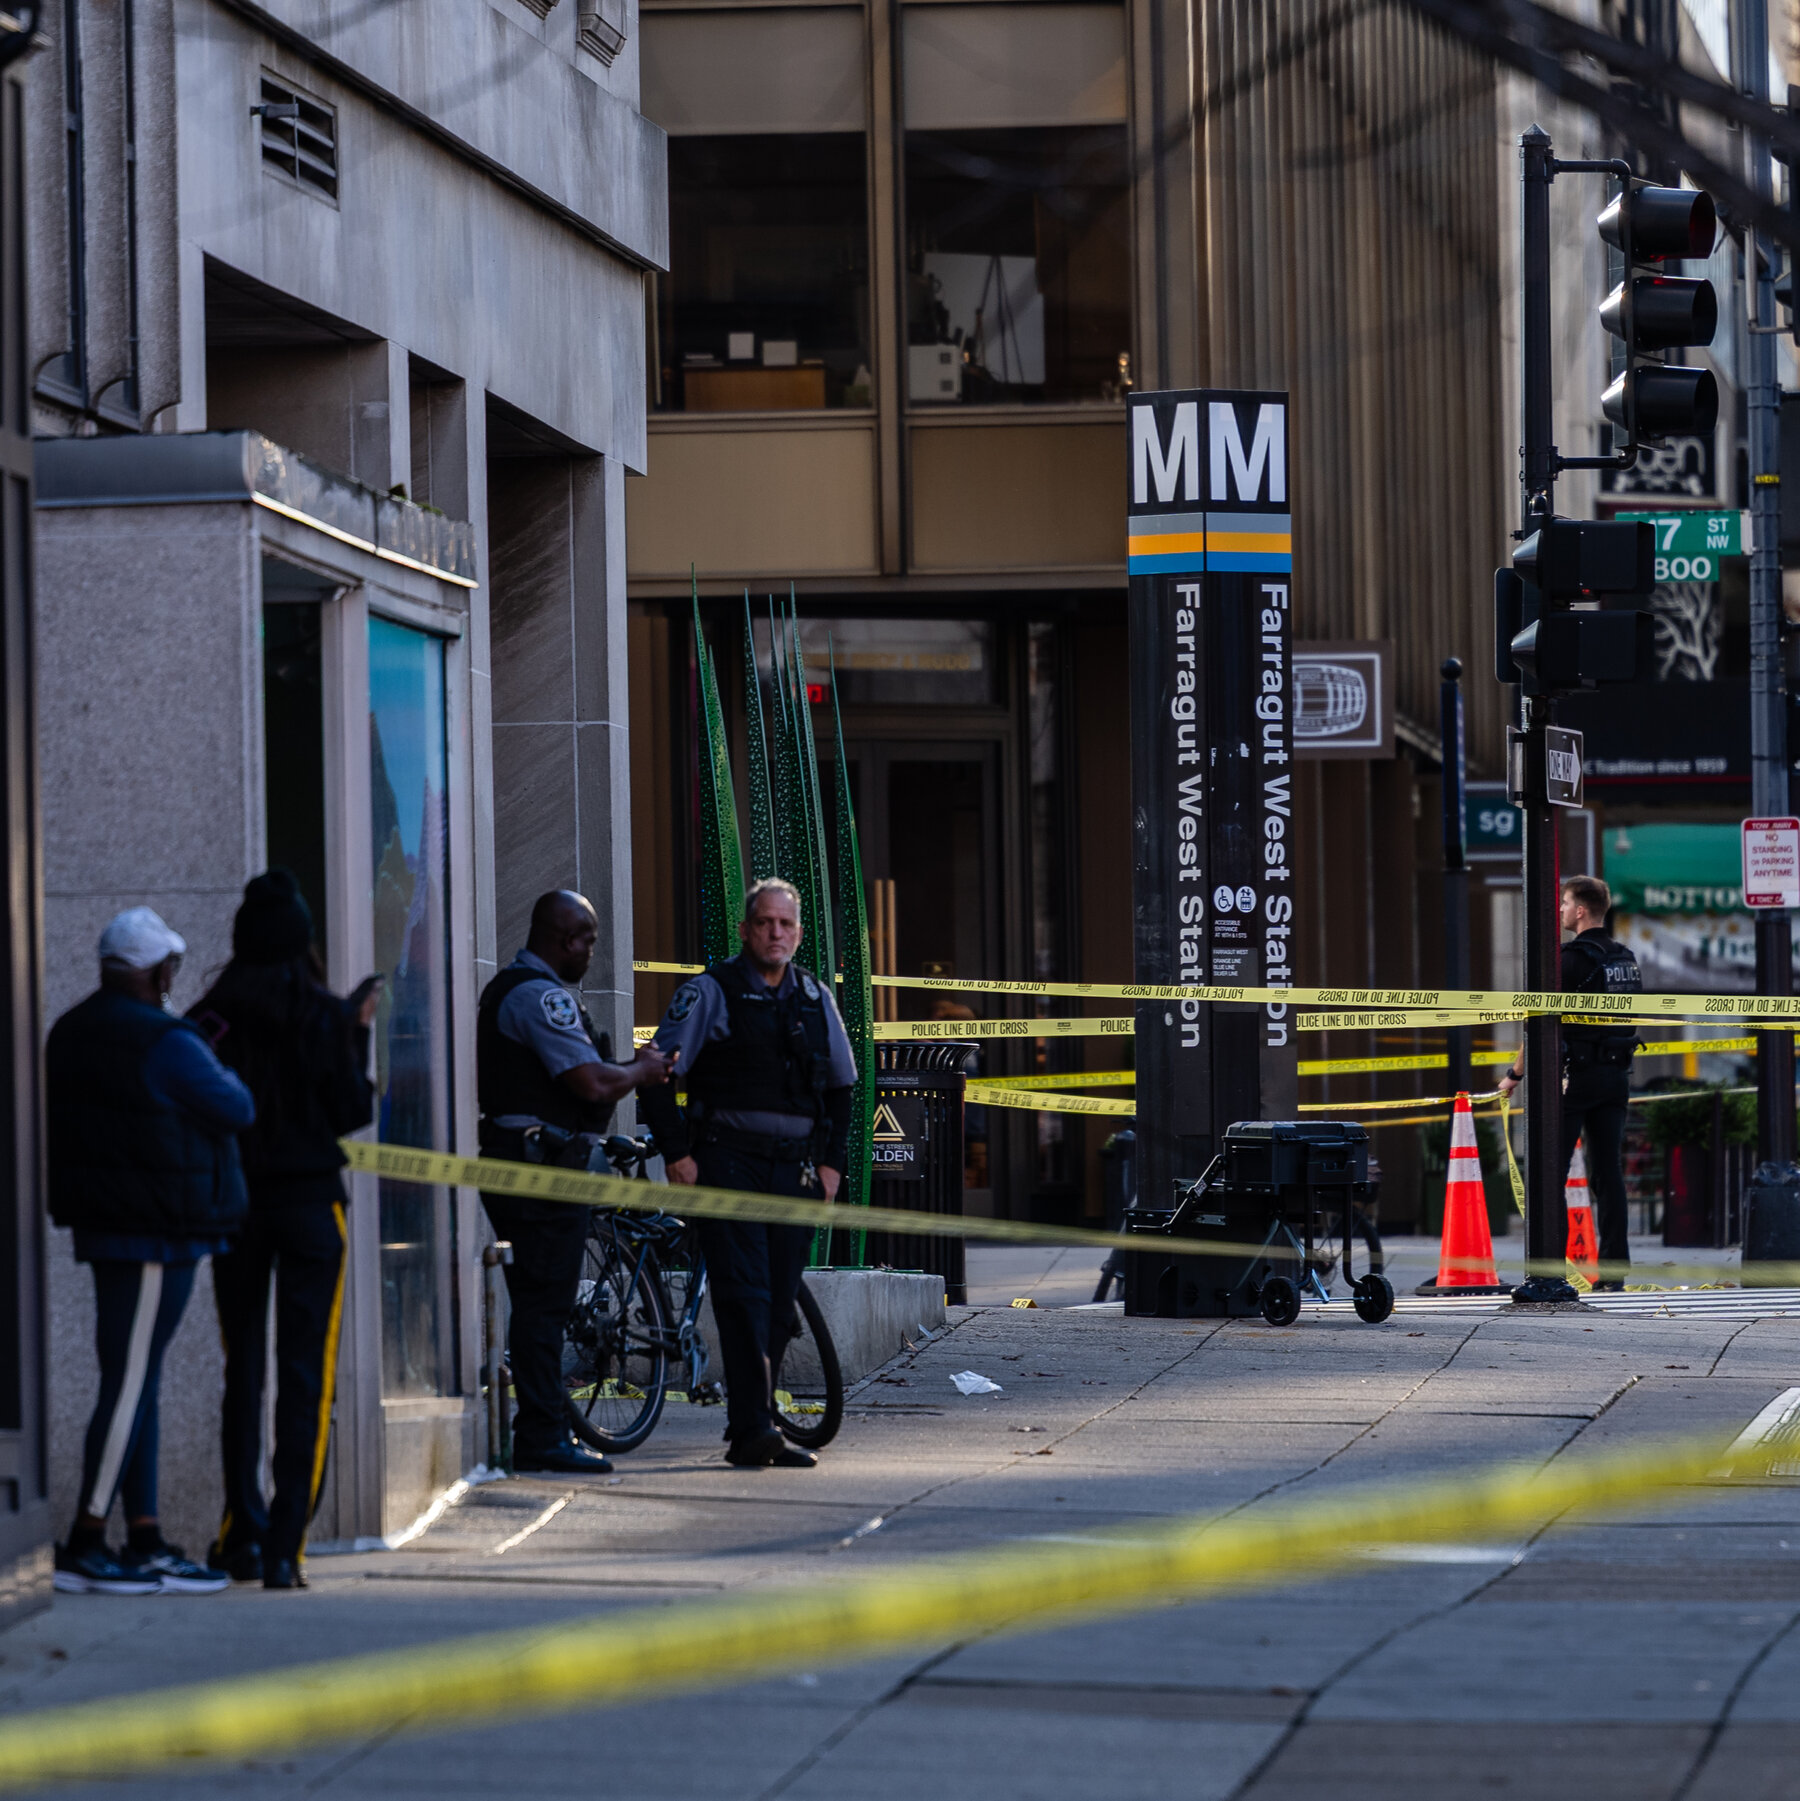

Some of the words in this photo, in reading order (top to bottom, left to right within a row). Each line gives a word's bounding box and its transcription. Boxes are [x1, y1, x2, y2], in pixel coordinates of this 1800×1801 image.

[1133, 402, 1199, 503] M
[1209, 402, 1285, 502] M
[1707, 518, 1729, 532] ST
[1706, 536, 1729, 549] NW
[1171, 583, 1200, 765] Farragut
[1256, 583, 1288, 765] Farragut
[1550, 751, 1561, 779] ONE
[1562, 754, 1573, 781] WAY
[1178, 773, 1203, 882] West
[1264, 773, 1291, 881] West
[1765, 833, 1779, 842] NO
[1752, 845, 1793, 855] STANDING
[1761, 857, 1795, 866] PARKING
[1753, 868, 1793, 877] ANYTIME
[1605, 966, 1640, 982] POLICE
[1296, 1014, 1320, 1028] OLICE
[1322, 1014, 1341, 1027] LINE
[1343, 1013, 1356, 1026] DO
[1358, 1013, 1375, 1026] NOT
[1378, 1013, 1407, 1026] CROSS
[1479, 1011, 1509, 1021] POLICE
[911, 1024, 941, 1036] POLICE
[944, 1023, 963, 1036] LINE
[965, 1022, 977, 1035] DO
[980, 1022, 997, 1035] NOT
[1000, 1021, 1028, 1035] CROSS
[1100, 1019, 1131, 1033] POLICE
